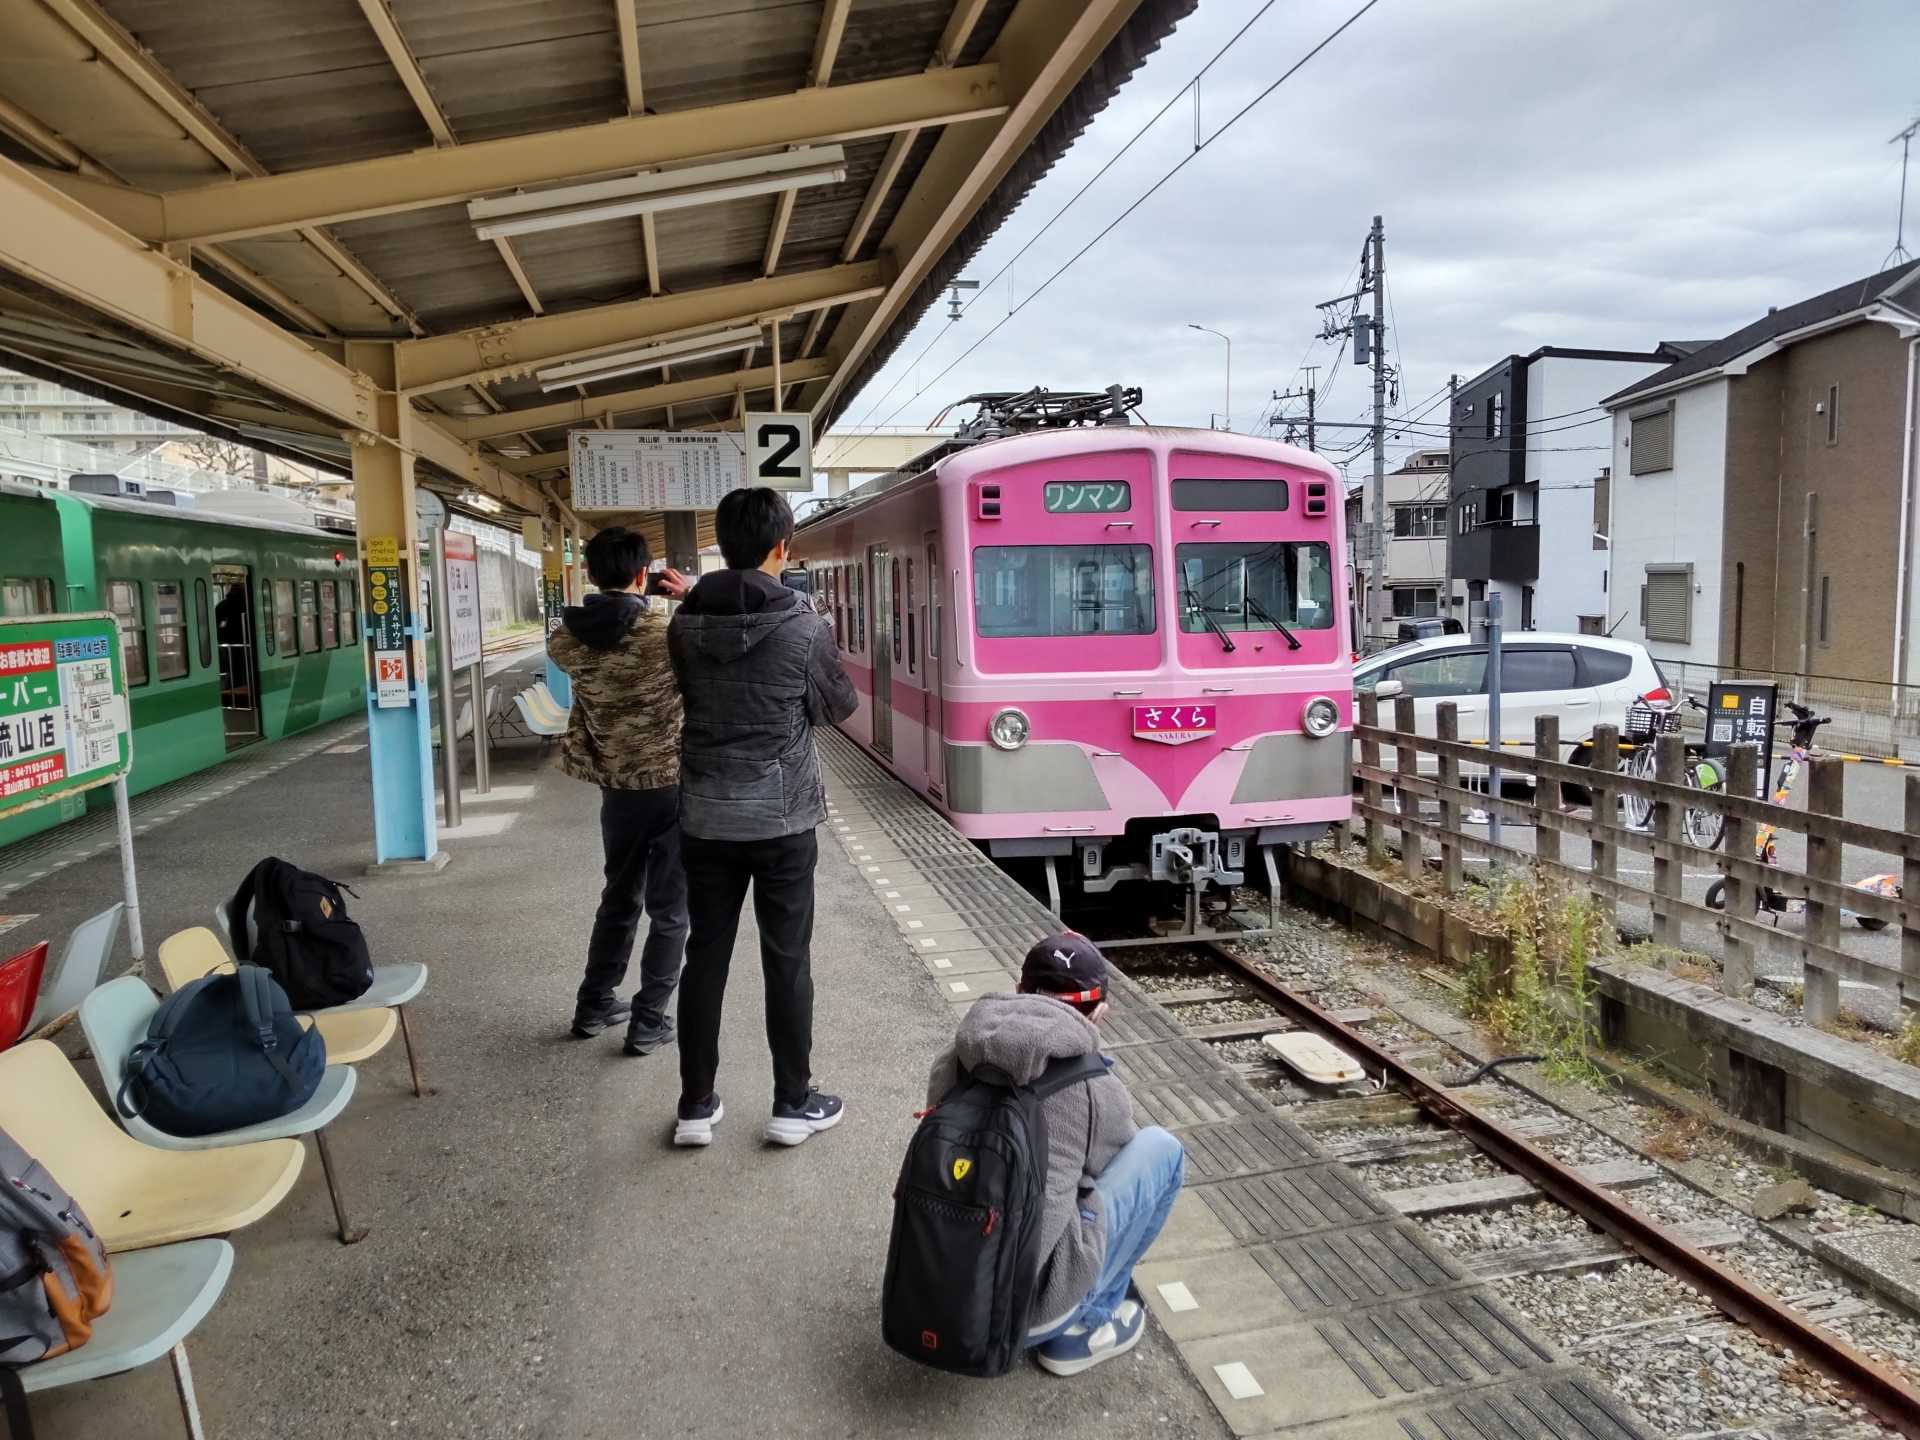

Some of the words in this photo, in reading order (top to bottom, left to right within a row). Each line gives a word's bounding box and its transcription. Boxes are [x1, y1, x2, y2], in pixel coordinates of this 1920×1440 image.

[758, 424, 801, 477] 2
[1046, 484, 1125, 511] ワンマン
[1145, 706, 1206, 728] さくら
[1158, 732, 1192, 740] SAKURA
